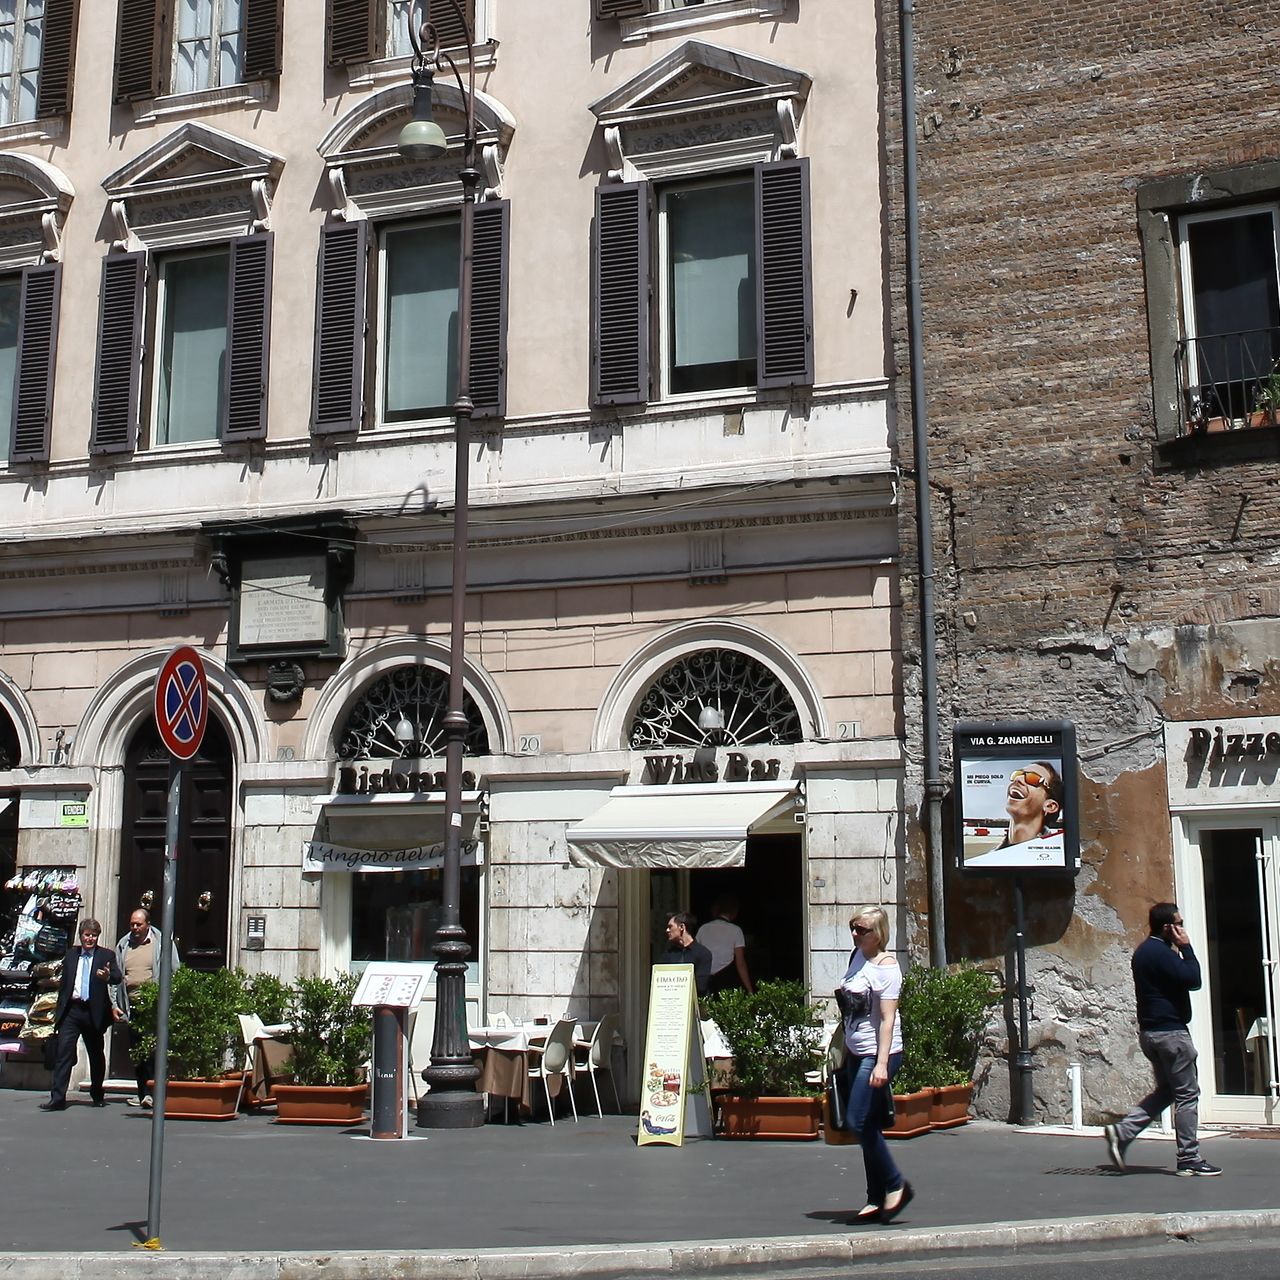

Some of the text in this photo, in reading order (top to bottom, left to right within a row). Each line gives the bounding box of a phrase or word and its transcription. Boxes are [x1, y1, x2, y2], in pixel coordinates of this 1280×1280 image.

[838, 723, 857, 739] 21
[520, 736, 540, 752] 20
[970, 735, 1053, 746] VIA G. ZANARDELLI
[641, 752, 781, 784] Wine Bar
[308, 845, 392, 868] L'Angolo
[395, 845, 426, 862] del
